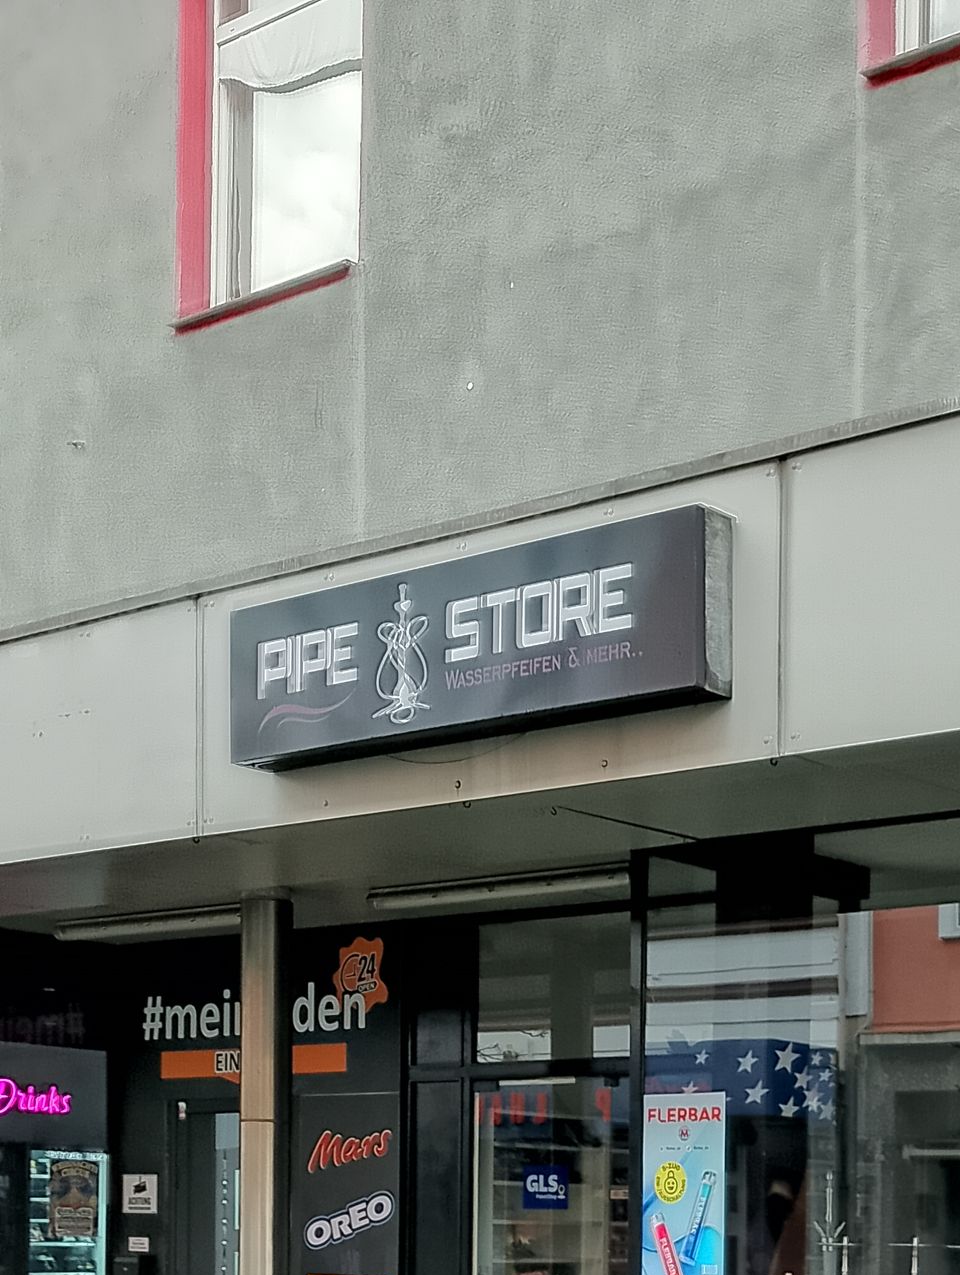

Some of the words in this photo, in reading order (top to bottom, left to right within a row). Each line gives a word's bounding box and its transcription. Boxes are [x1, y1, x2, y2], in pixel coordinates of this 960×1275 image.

[256, 621, 359, 700] PIPE
[444, 562, 633, 663] STORE
[444, 655, 562, 691] WASSERPFEIFEN
[357, 953, 377, 982] 24
[215, 1052, 241, 1072] EIN
[647, 1106, 722, 1123] FLERBAR
[307, 1129, 393, 1174] Mars
[526, 1174, 559, 1193] GLS
[305, 1193, 393, 1247] OREO
